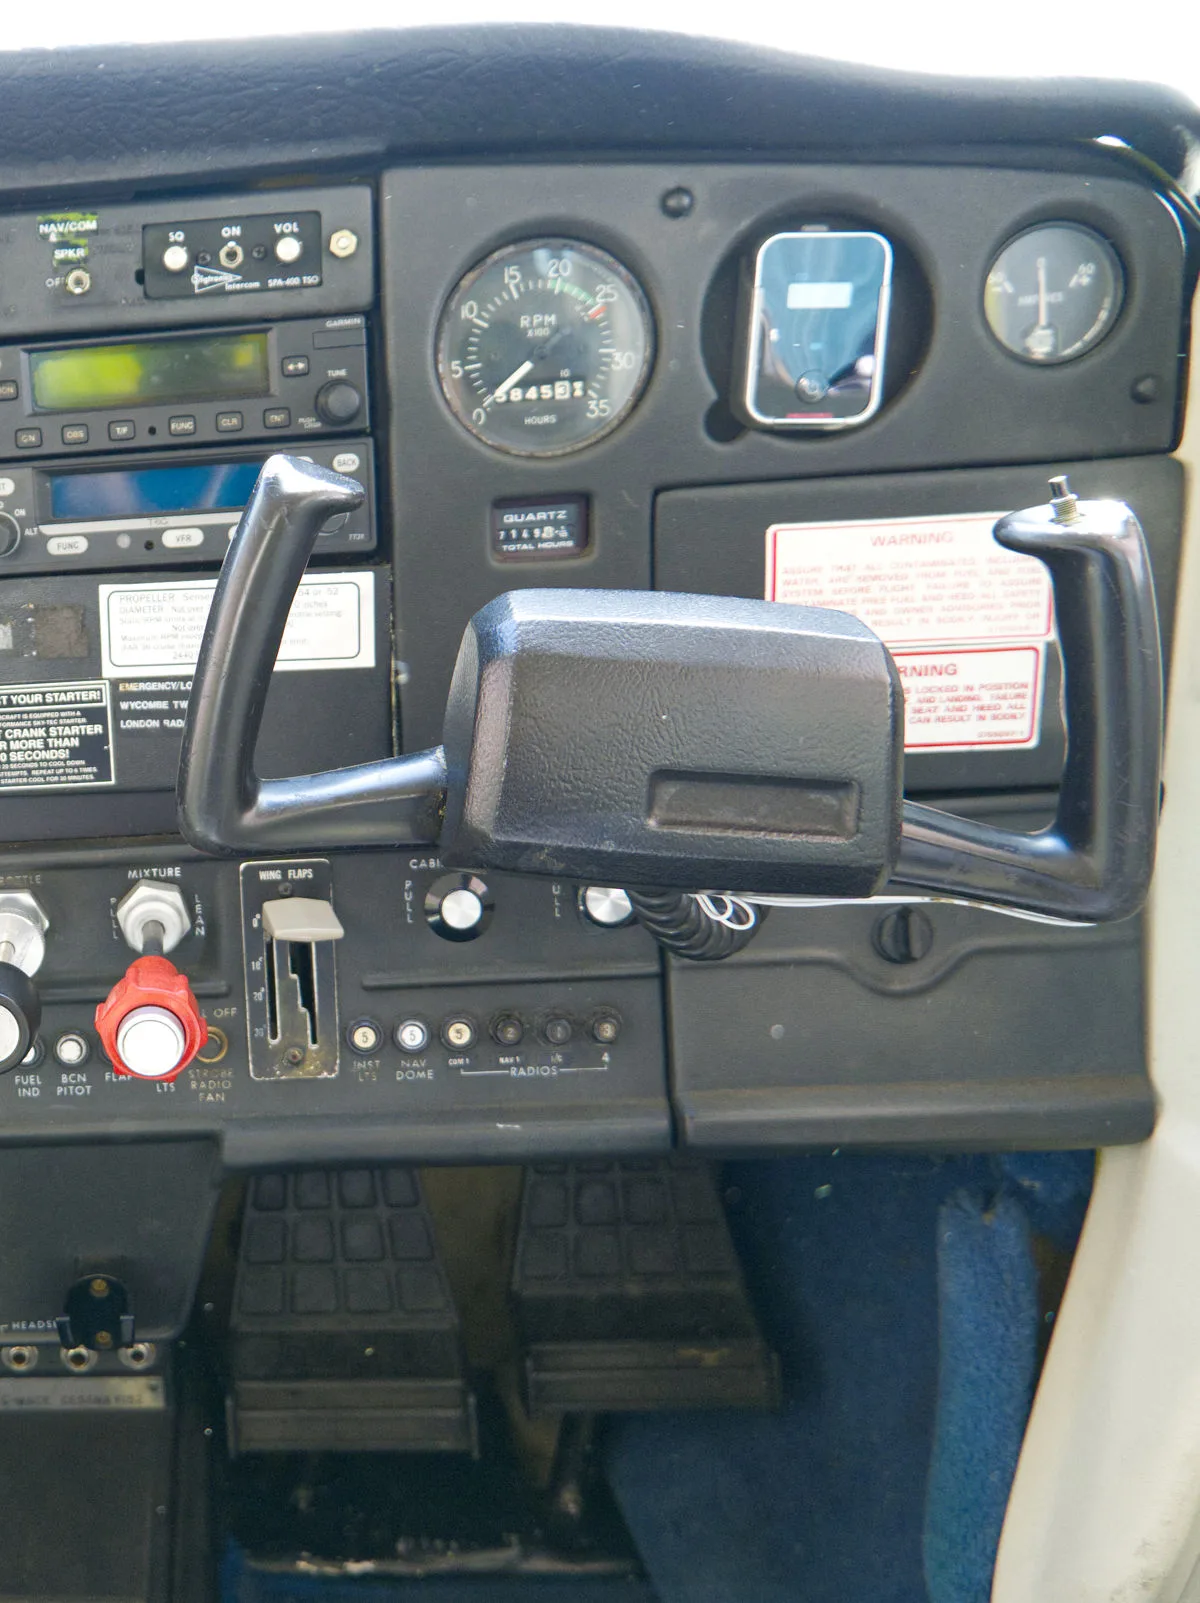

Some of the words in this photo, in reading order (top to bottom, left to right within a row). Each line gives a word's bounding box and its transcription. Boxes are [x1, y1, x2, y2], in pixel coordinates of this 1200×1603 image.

[39, 220, 98, 233] NAV/COM
[221, 226, 241, 237] ON
[273, 222, 300, 234] VOL
[169, 231, 185, 242] SQ
[54, 248, 86, 260] SPKR
[547, 259, 572, 276] 20
[302, 275, 319, 285] TSO
[503, 266, 521, 284] 15
[225, 280, 260, 291] Intercom
[595, 284, 618, 303] 25
[460, 300, 478, 319] 10
[325, 317, 361, 328] GARMIN
[520, 314, 557, 329] RPM
[611, 352, 636, 370] 30
[327, 369, 348, 378] TUNE
[450, 360, 464, 379] 5
[586, 400, 611, 418] 35
[472, 408, 486, 425] 0
[524, 414, 557, 426] HOURS
[171, 420, 194, 431] FUNC
[336, 458, 357, 468] BACK
[14, 508, 26, 517] ON
[503, 510, 568, 523] QUARTZ
[24, 527, 39, 536] ALT
[175, 534, 192, 543] VFR
[870, 530, 955, 547] WARNING
[56, 541, 80, 550] FUNC
[502, 543, 535, 552] TOTAL
[537, 540, 574, 549] HOURS
[120, 593, 175, 603] PROPELLER
[897, 663, 958, 677] RNING
[915, 684, 959, 694] LOCKED
[963, 683, 974, 692] IN
[978, 681, 1029, 691] POSITION
[10, 692, 44, 705] YOUR
[45, 690, 101, 703] STARTER!
[990, 692, 1027, 701] FAILURE
[120, 700, 169, 710] WYCOMBE
[911, 705, 938, 714] SEAT
[945, 704, 968, 713] AND
[972, 702, 1002, 711] HEED
[1006, 701, 1027, 710] ALL
[29, 711, 59, 719] EQUIPPED
[909, 715, 931, 724] CAN
[935, 713, 973, 723] RESULT
[976, 713, 987, 721] IN
[990, 711, 1026, 721] BODILY
[120, 719, 160, 729] LONDON
[4, 727, 47, 739] CRANK
[49, 724, 104, 736] STARTER
[9, 739, 45, 751] MORE
[47, 737, 80, 748] THAN
[9, 749, 70, 761] SECONDS!
[9, 761, 39, 769] SECONDS
[0, 776, 28, 785] STARTER
[128, 866, 182, 879] MIXTURE
[259, 869, 282, 881] WING
[288, 868, 313, 879] FLAPS
[213, 1007, 237, 1018] OFF
[362, 1031, 369, 1043] 5
[409, 1029, 416, 1041] 5
[401, 1060, 427, 1069] NAV
[396, 1069, 434, 1081] DOME
[510, 1066, 558, 1077] RADIOS
[14, 1074, 42, 1085] FUEL
[61, 1073, 87, 1084] BCN
[56, 1085, 92, 1096] PITOT
[156, 1082, 176, 1093] LTS
[190, 1080, 232, 1090] RADIO
[18, 1086, 40, 1097] IND
[199, 1091, 226, 1102] FAN
